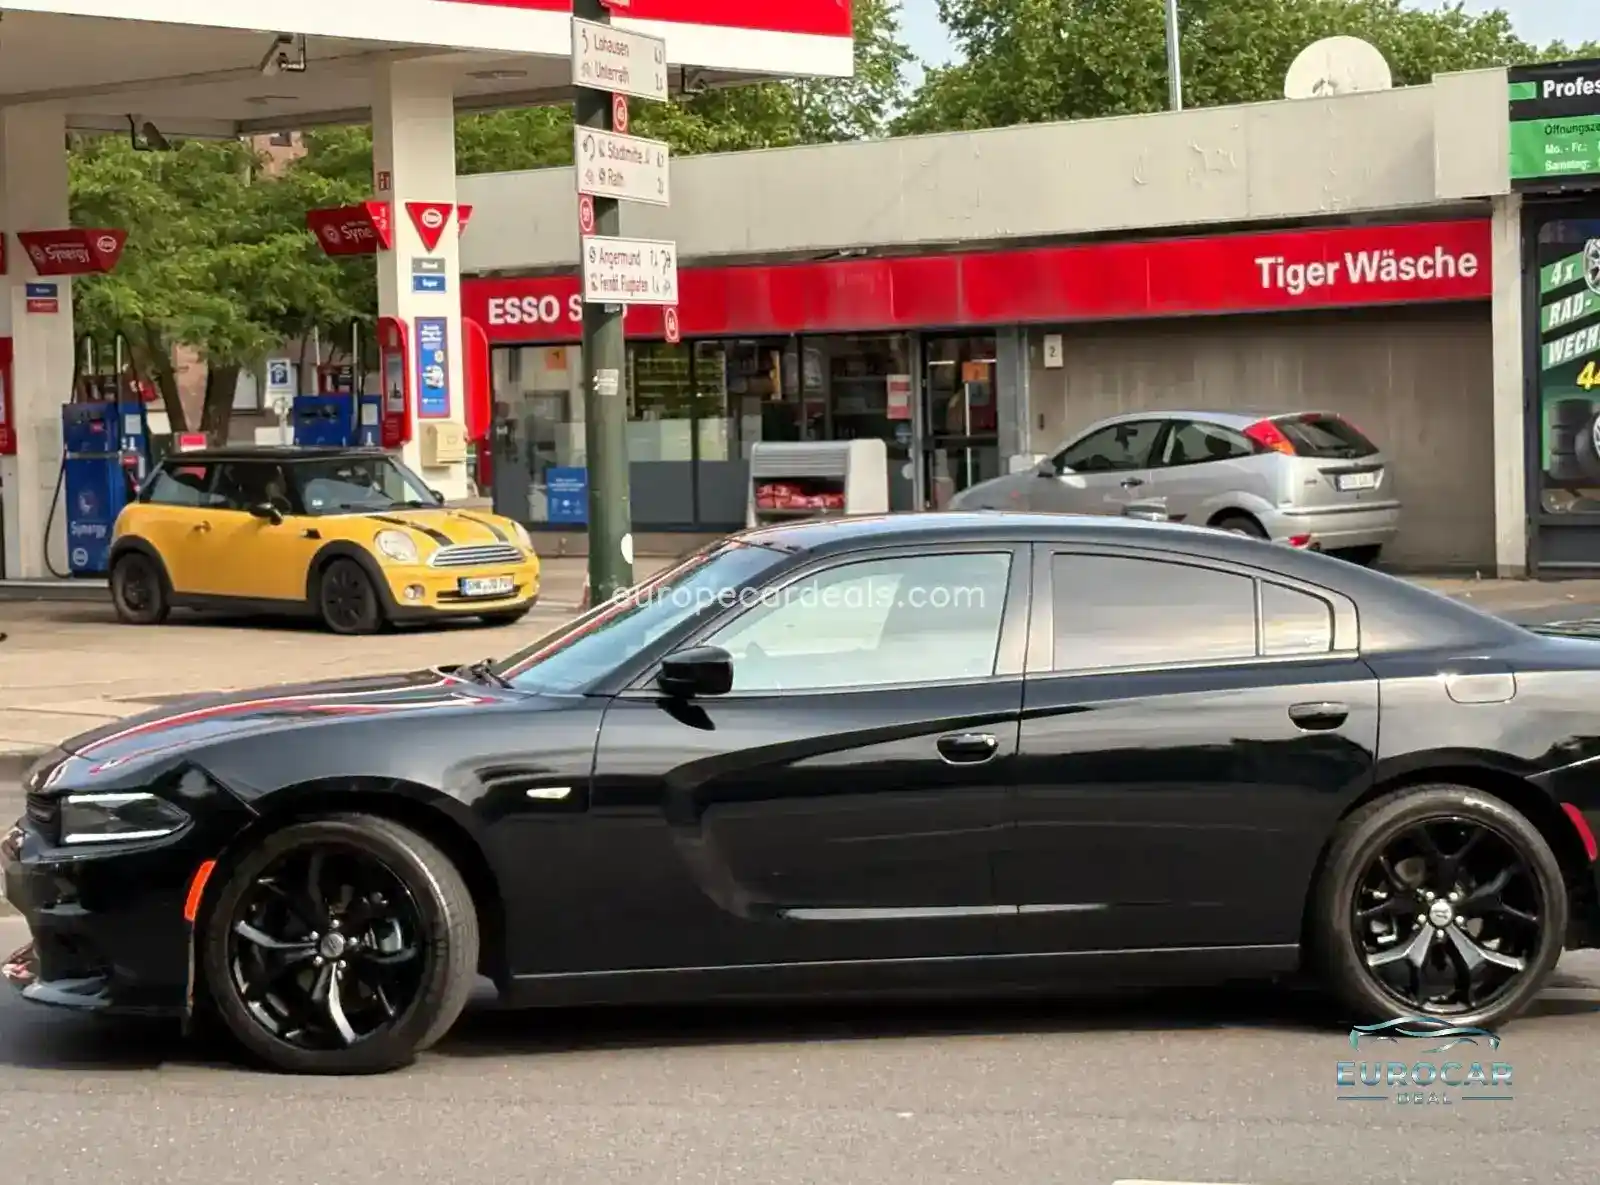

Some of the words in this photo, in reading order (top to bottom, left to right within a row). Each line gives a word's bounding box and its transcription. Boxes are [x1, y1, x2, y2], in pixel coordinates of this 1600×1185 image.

[600, 247, 641, 271] Angermund
[1254, 256, 1340, 295] Tiger
[1344, 246, 1478, 284] Wäsche
[1551, 262, 1574, 286] 4x
[488, 295, 560, 325] ESSO
[1549, 292, 1592, 327] RAD-
[1549, 323, 1600, 363] WECH
